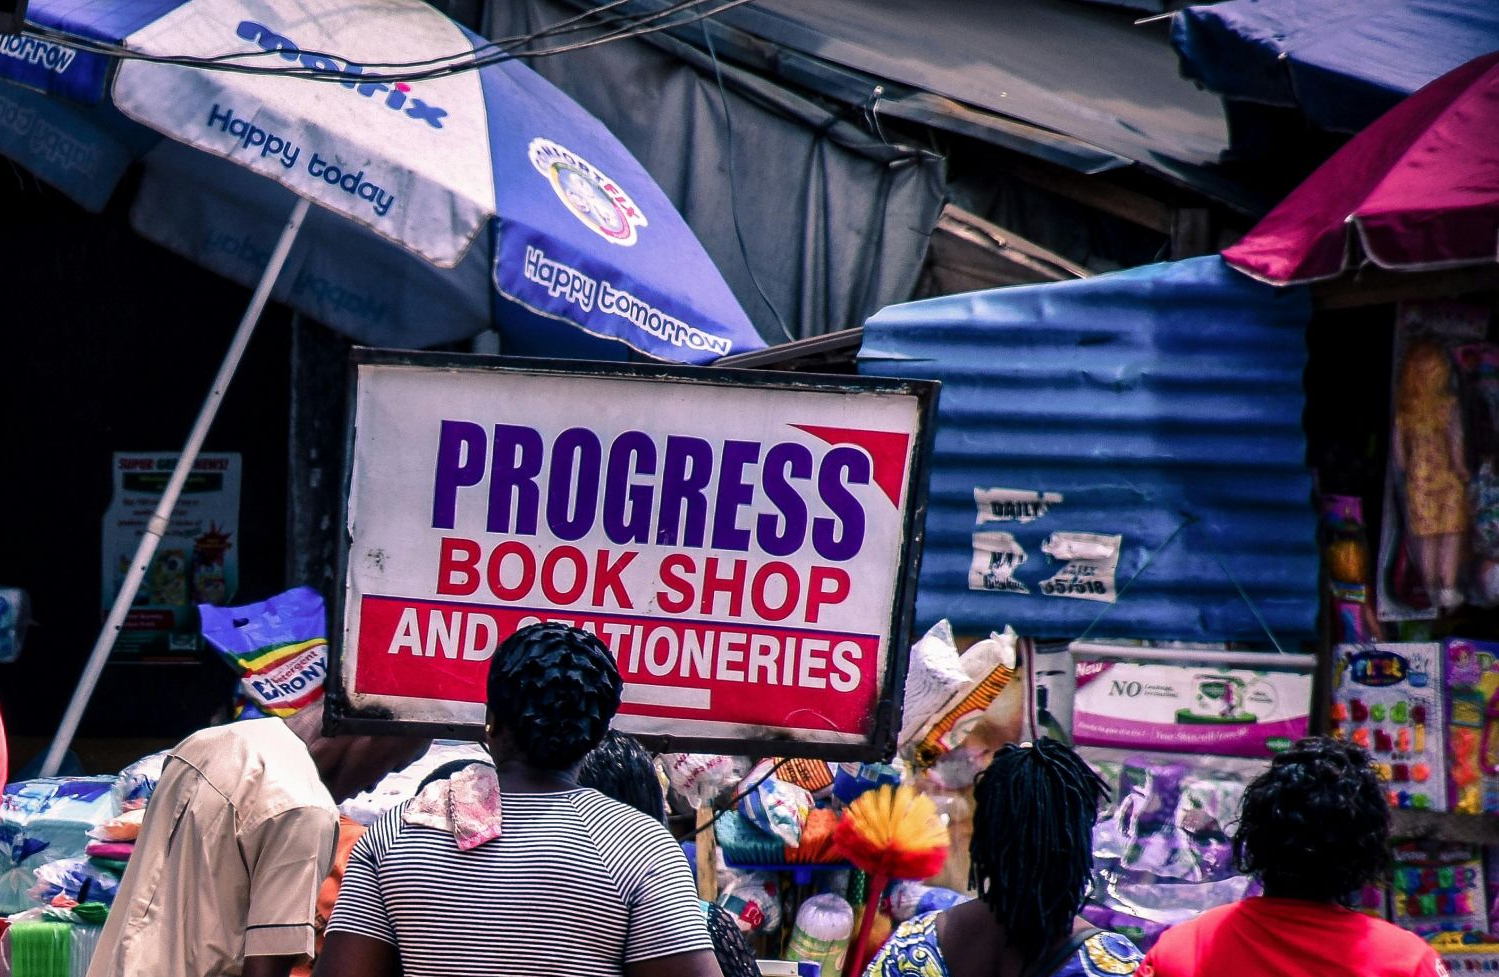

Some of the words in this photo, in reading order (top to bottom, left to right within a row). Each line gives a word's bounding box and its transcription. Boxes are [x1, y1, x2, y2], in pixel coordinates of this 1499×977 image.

[206, 103, 301, 169] Happy
[307, 153, 394, 216] today
[526, 247, 597, 311] Happy
[598, 281, 733, 356] tomorrow
[431, 418, 874, 562] PROGRESS
[436, 536, 639, 609] BOOK
[656, 553, 852, 624] SHOP
[388, 606, 499, 662] AND
[516, 615, 863, 693] TIONERIES
[1108, 679, 1142, 698] NO
